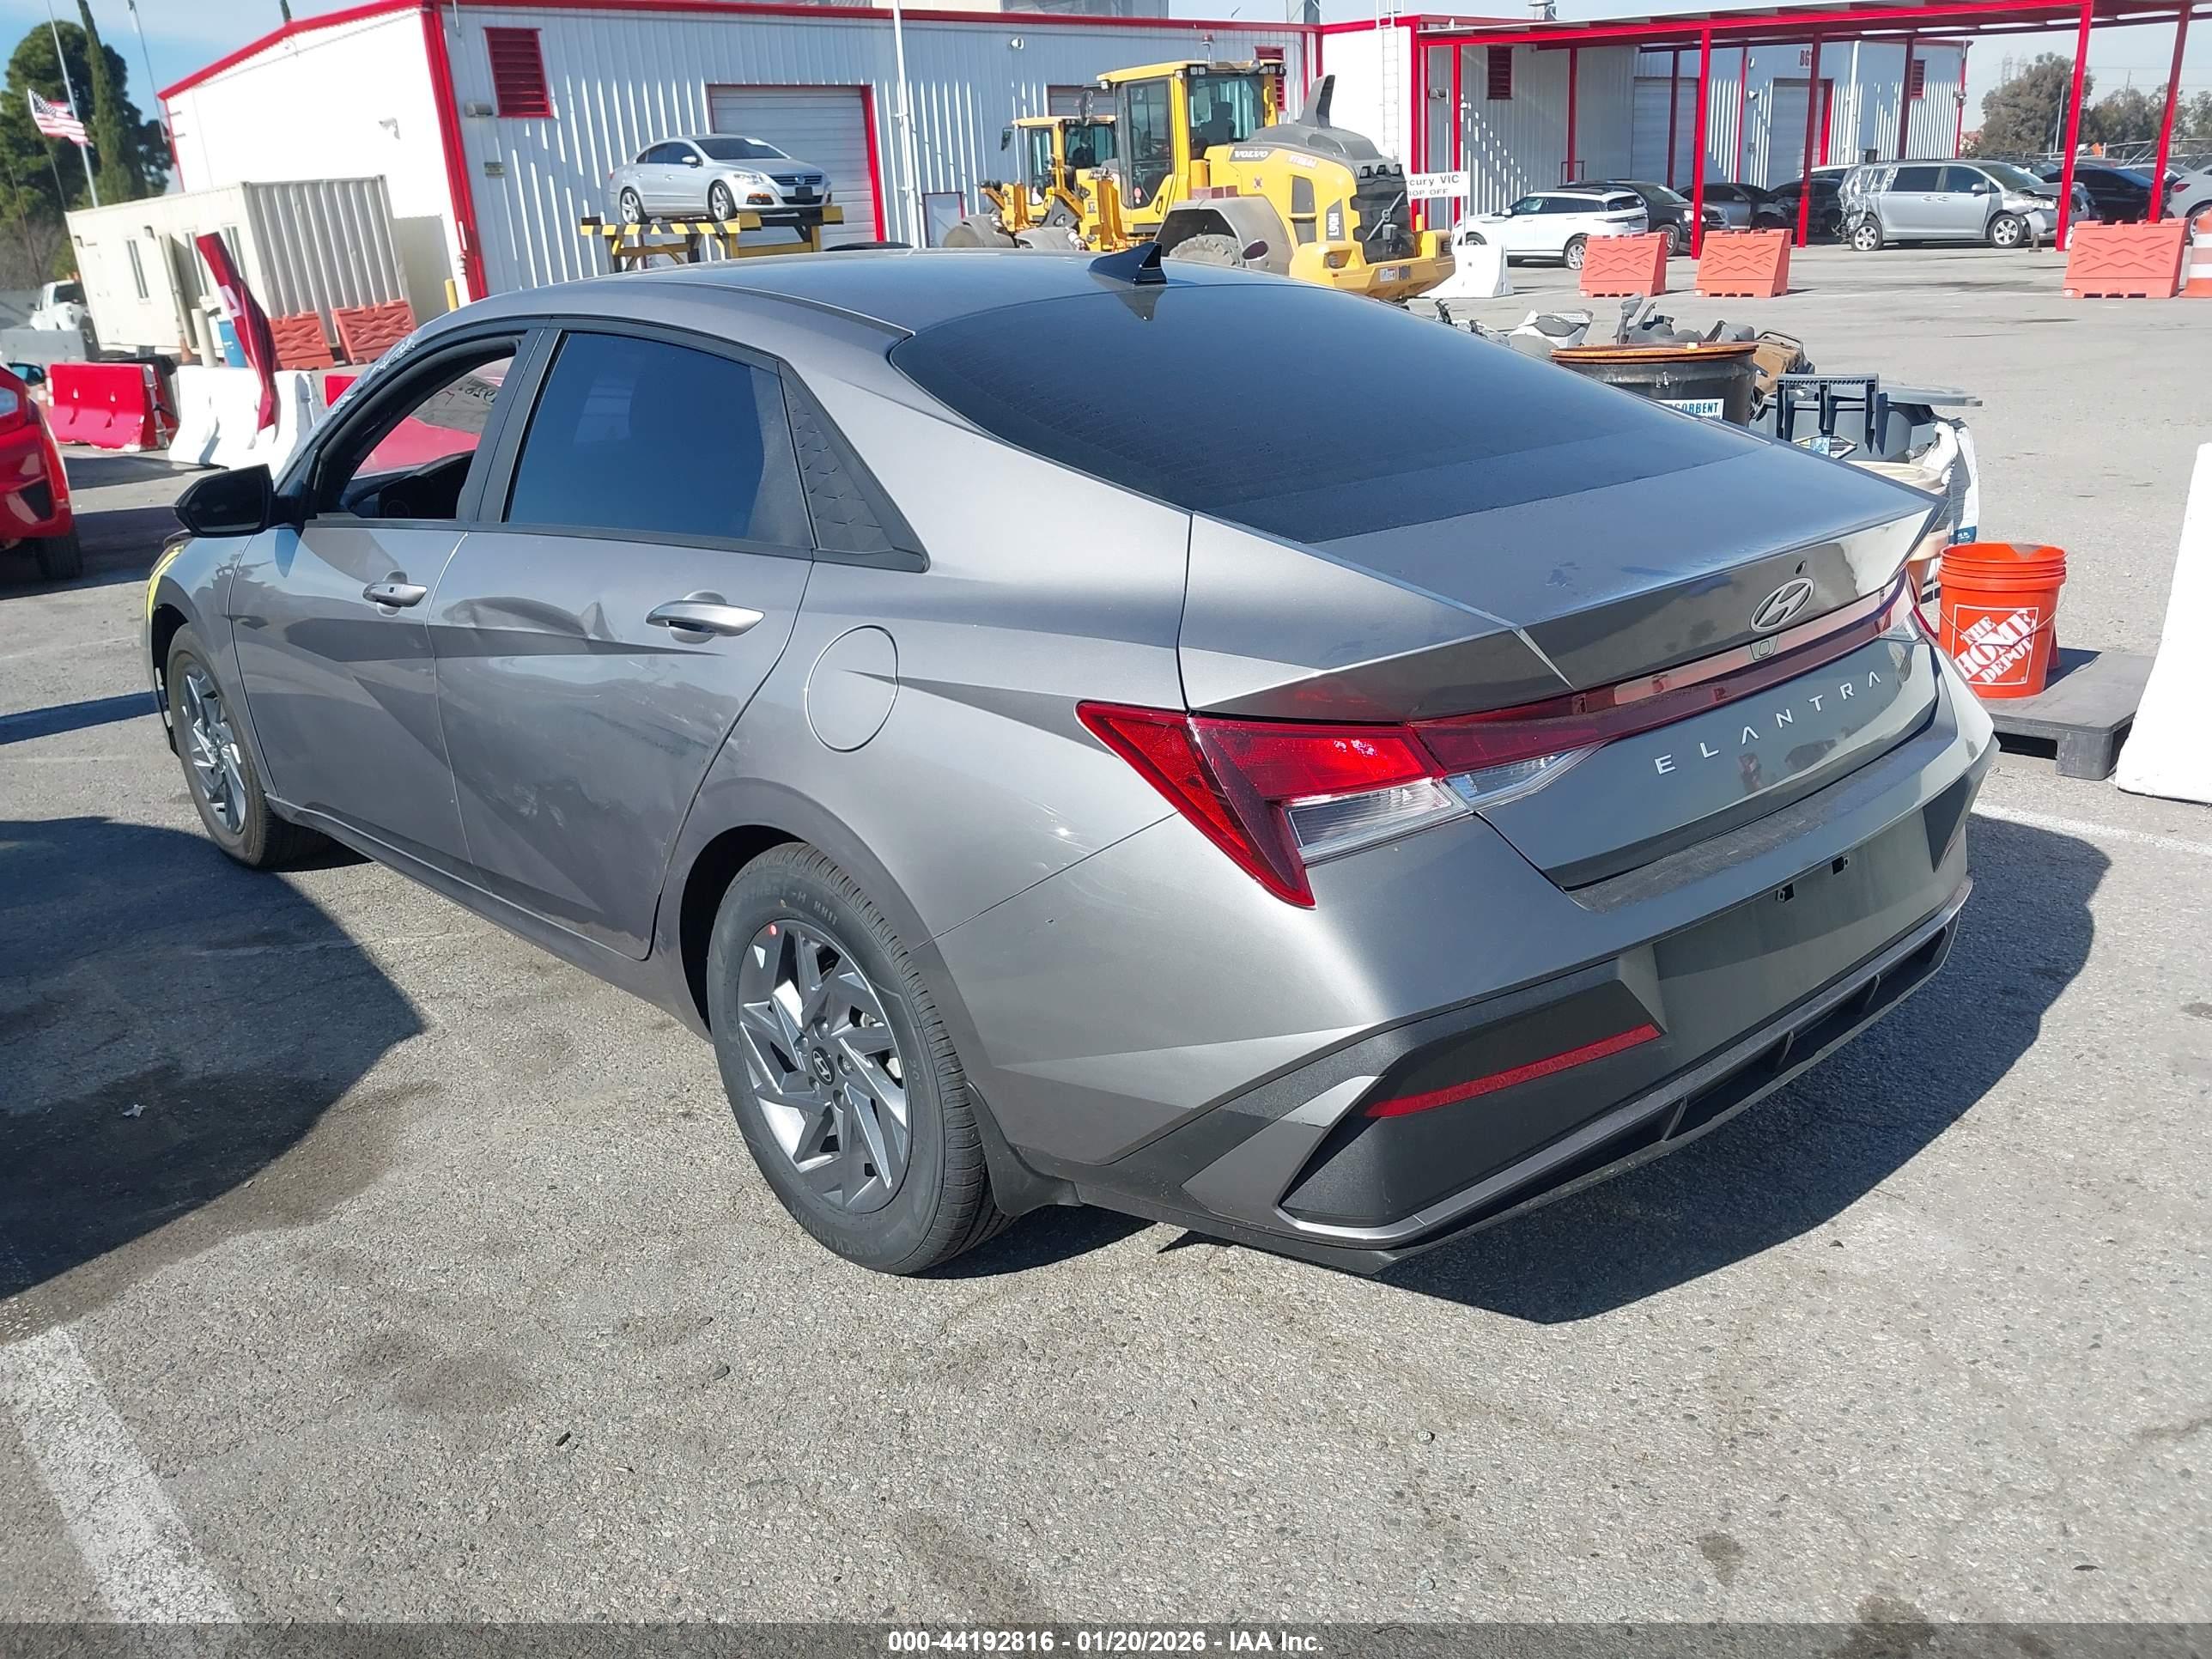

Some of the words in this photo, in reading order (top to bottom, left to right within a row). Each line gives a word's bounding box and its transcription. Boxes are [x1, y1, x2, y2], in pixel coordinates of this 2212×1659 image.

[1234, 150, 1269, 159] VOLVO
[1406, 179, 1434, 187] cury
[1440, 174, 1460, 185] VIC
[1328, 212, 1340, 236] L90H
[1669, 402, 1719, 414] SORBENT
[1954, 609, 2036, 680] HOME
[1960, 616, 1997, 646] THE
[1978, 636, 2032, 684] DEPOT
[1655, 672, 1881, 775] ELANTRA
